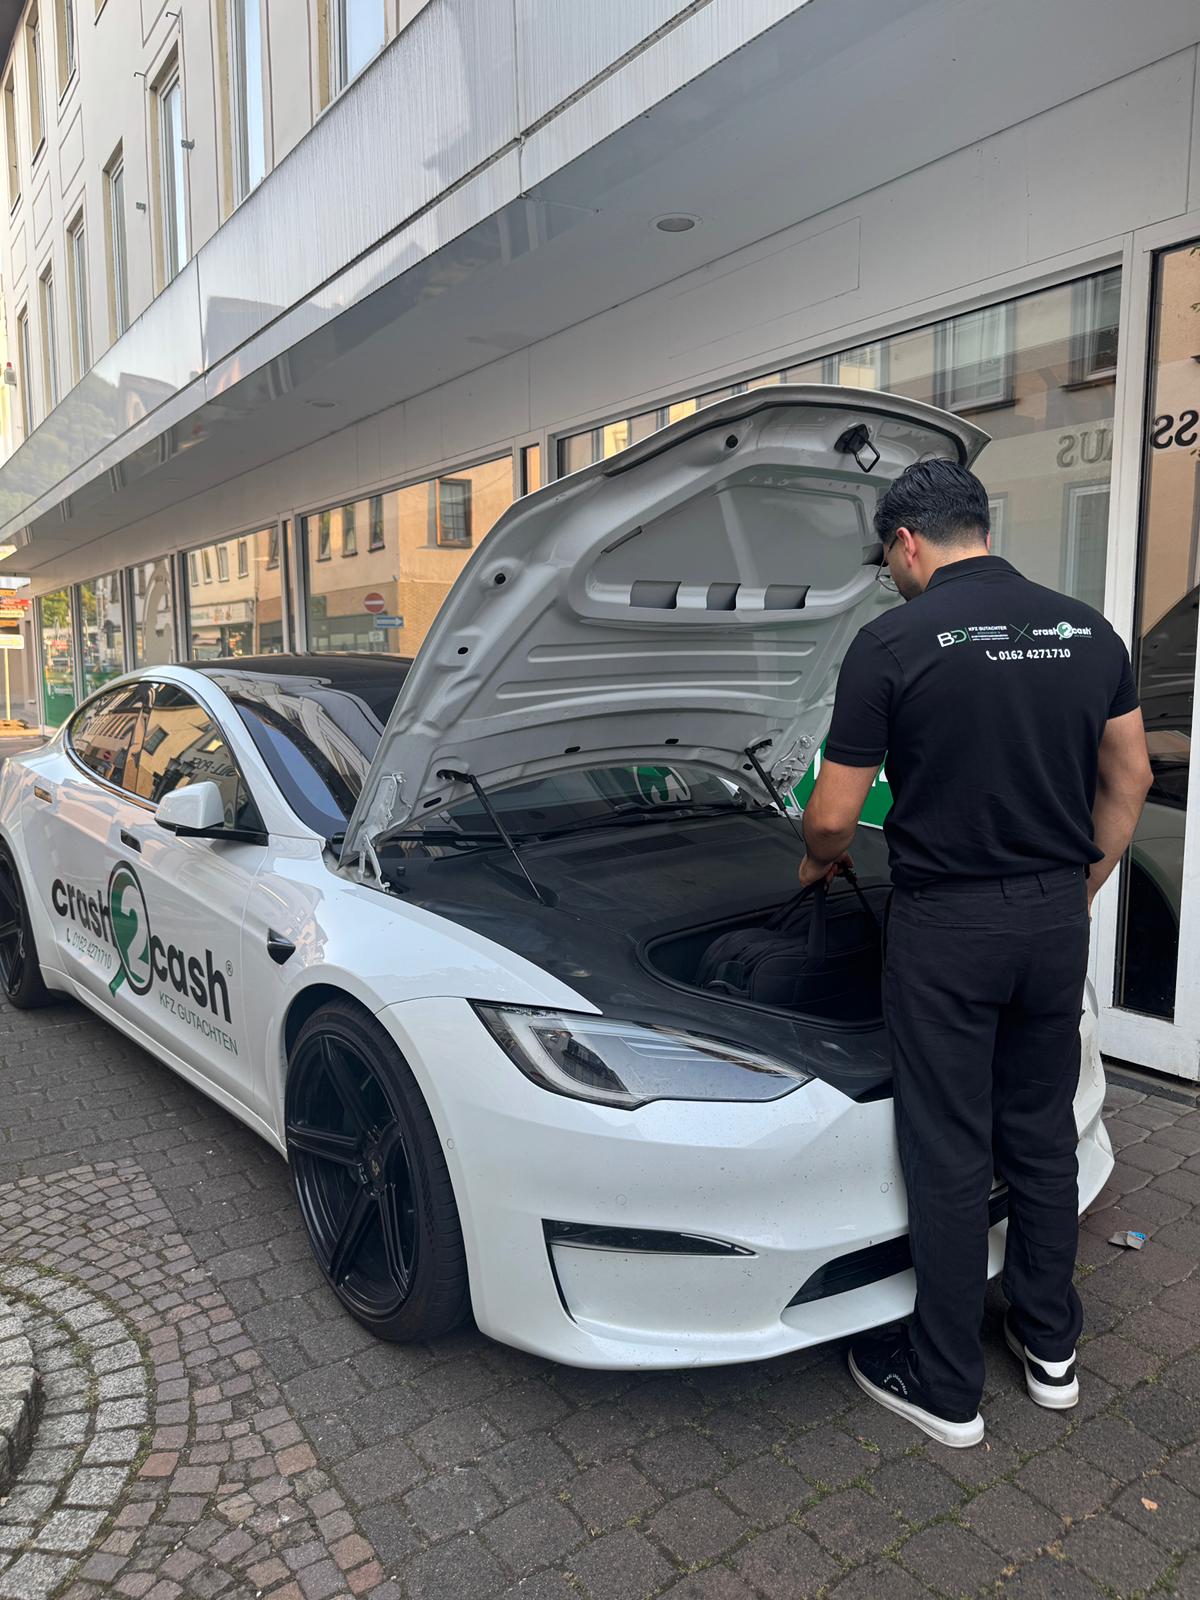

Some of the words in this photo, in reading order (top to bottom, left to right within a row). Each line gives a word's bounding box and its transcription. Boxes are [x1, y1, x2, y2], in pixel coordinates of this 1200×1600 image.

[999, 650, 1024, 661] 0162
[1026, 649, 1071, 660] 4271710
[159, 992, 176, 1014] KFZ
[177, 1003, 239, 1056] GUTACHTEN
